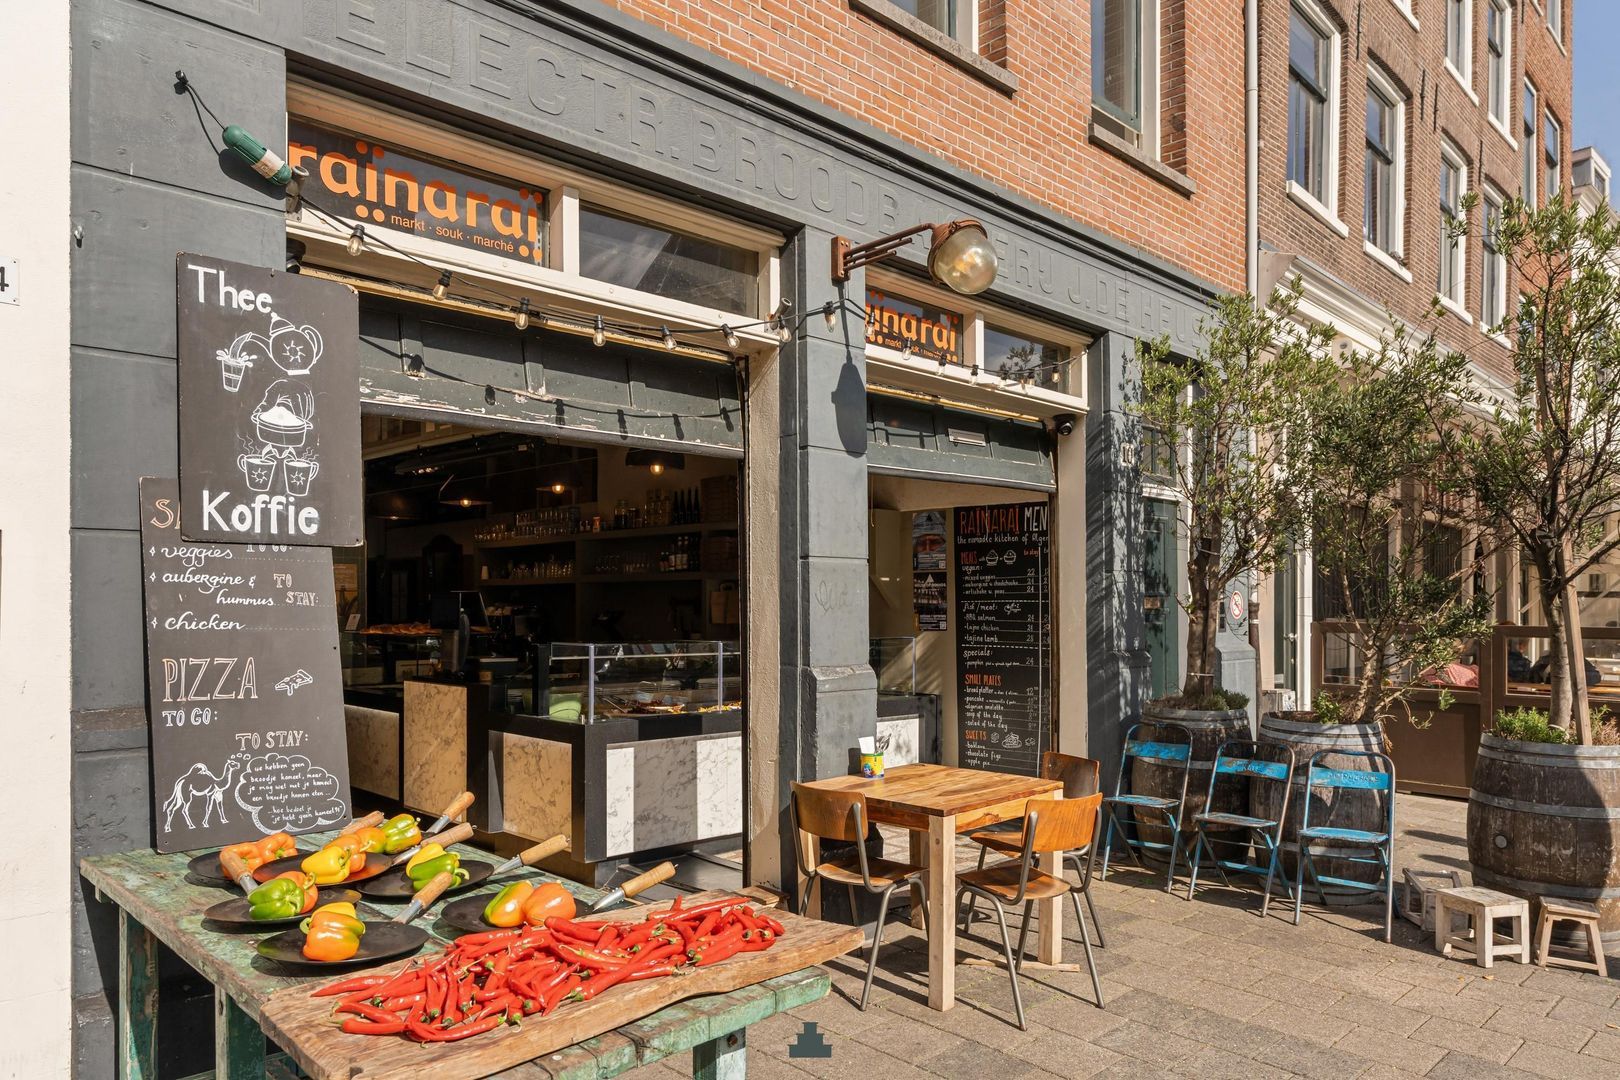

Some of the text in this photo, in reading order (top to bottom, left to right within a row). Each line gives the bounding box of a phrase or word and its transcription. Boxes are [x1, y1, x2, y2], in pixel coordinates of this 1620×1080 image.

[391, 214, 514, 253] markt souk marché
[188, 264, 273, 313] Thee
[202, 489, 320, 535] Koffie
[1024, 505, 1048, 532] MEN
[957, 535, 967, 544] the
[994, 533, 1019, 542] kitchen
[1021, 533, 1028, 545] of
[161, 545, 233, 567] veggies
[273, 573, 292, 588] TO
[216, 588, 274, 606] hummus
[164, 611, 246, 630] chicken
[962, 646, 993, 659] specials:
[162, 656, 259, 702] PIZZA
[162, 707, 218, 727] TO GO:
[235, 730, 309, 750] TO STAY:
[264, 762, 288, 770] hebben
[291, 763, 305, 771] geen
[247, 785, 255, 794] je
[259, 785, 273, 794] mag
[302, 781, 310, 790] je
